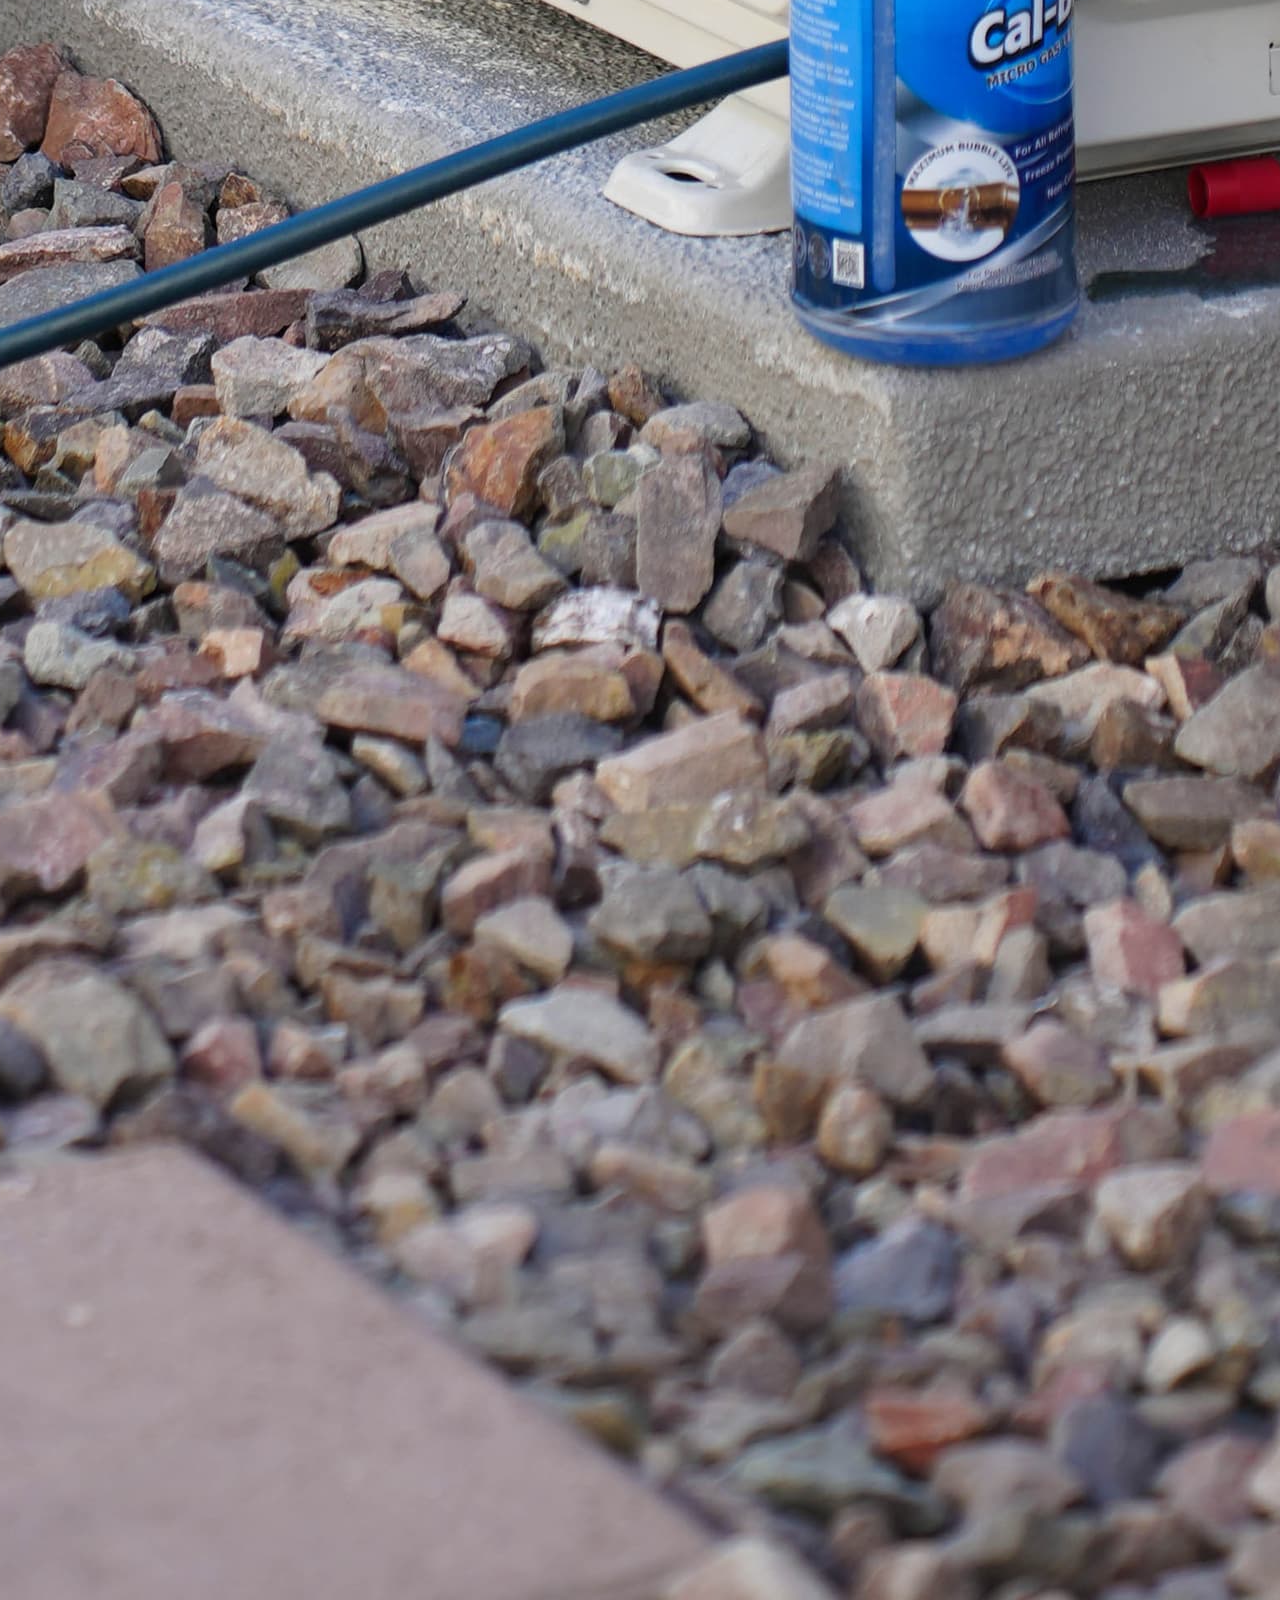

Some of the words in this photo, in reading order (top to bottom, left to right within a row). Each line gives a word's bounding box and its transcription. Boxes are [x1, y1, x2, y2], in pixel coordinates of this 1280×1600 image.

[986, 59, 1035, 89] MICRO
[1015, 145, 1032, 158] For
[1035, 136, 1047, 149] All
[907, 144, 954, 186] MAXIMUM
[958, 141, 997, 159] BUBBLE
[998, 157, 1015, 179] LIFE
[1025, 162, 1054, 182] Freeze
